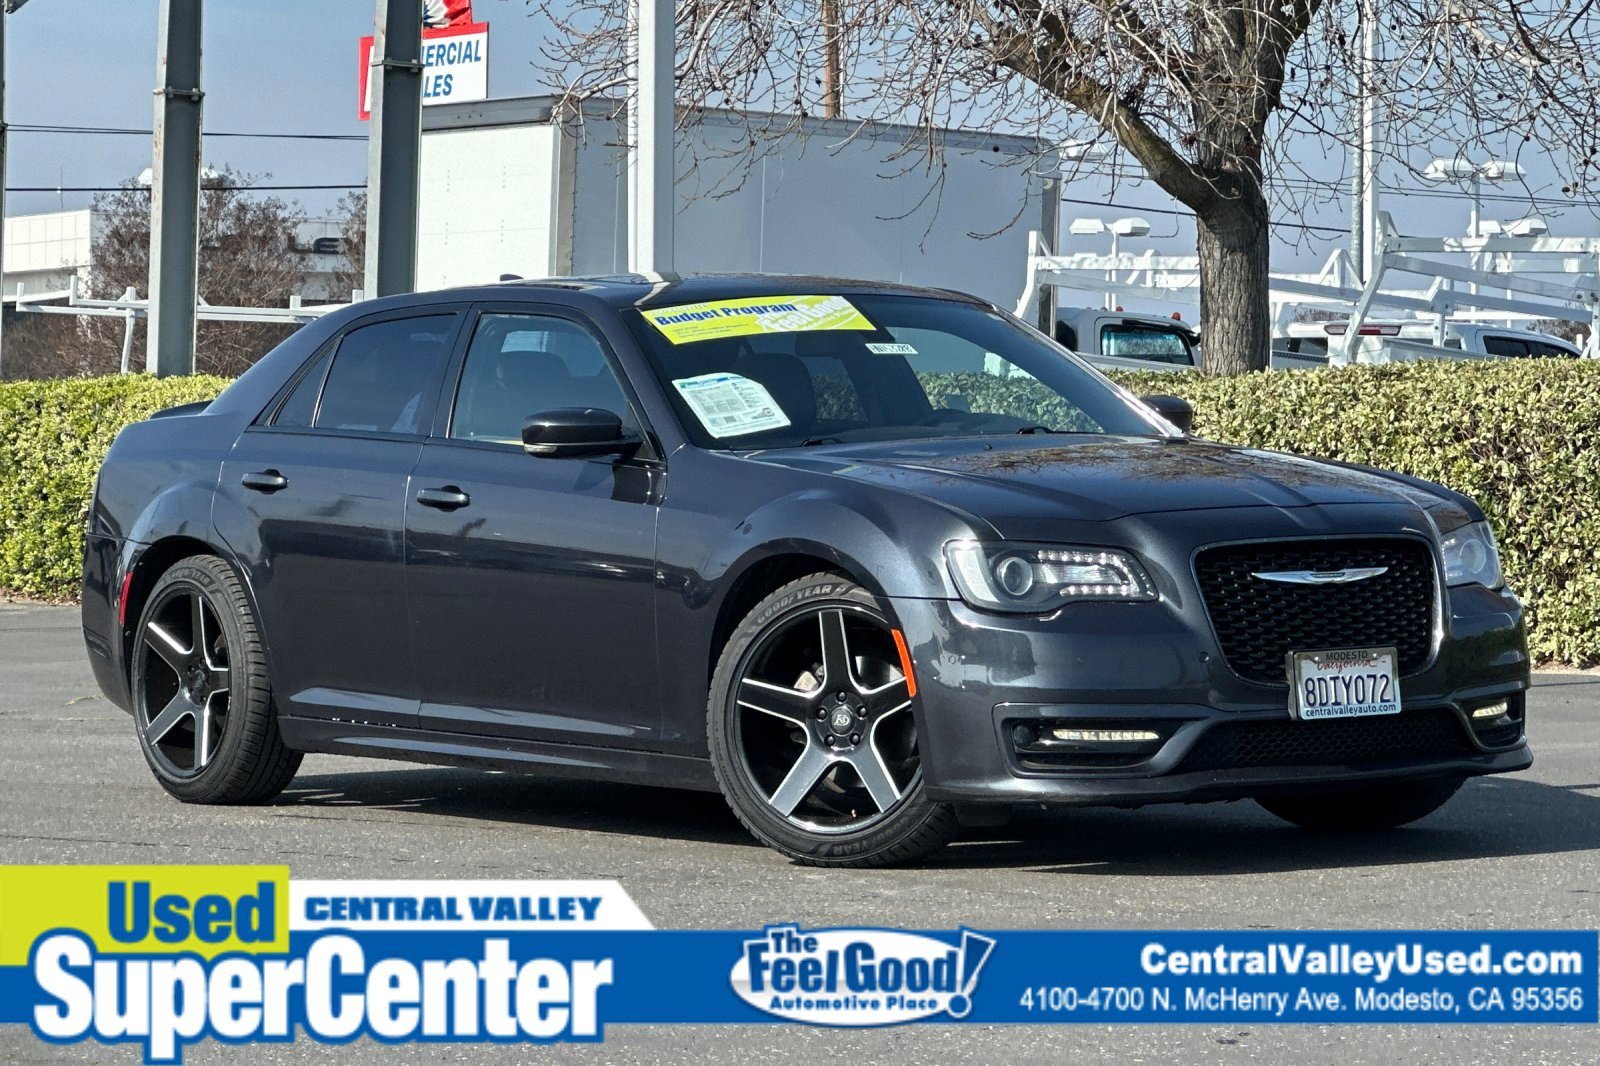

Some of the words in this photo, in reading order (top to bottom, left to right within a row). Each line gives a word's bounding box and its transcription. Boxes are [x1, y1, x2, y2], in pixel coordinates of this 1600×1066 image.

[422, 40, 482, 67] ERCIAL
[423, 74, 453, 98] LES
[654, 308, 720, 327] Budget
[723, 302, 798, 319] Program
[1326, 651, 1368, 661] MODESTO
[1304, 674, 1391, 707] 8DIY072
[1305, 703, 1396, 717] centralvalleyauto.com
